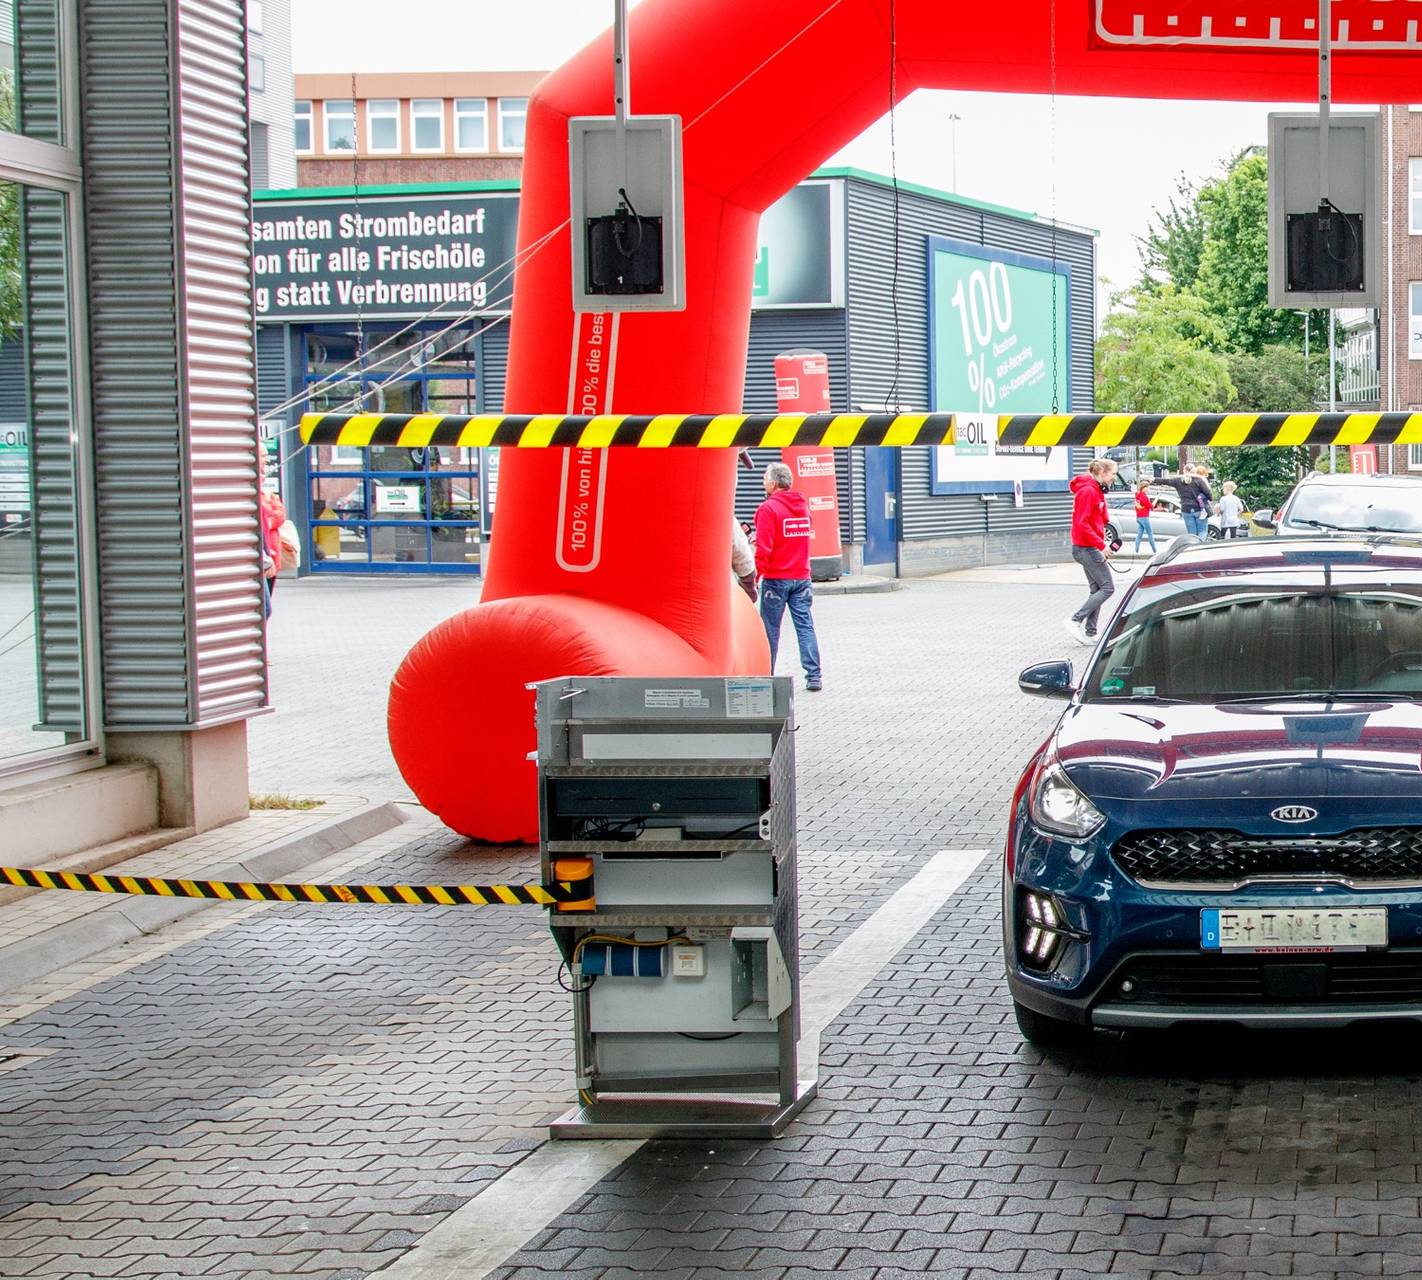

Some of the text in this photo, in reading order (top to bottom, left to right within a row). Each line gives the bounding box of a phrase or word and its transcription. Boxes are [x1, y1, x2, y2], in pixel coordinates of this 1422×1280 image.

[339, 207, 485, 239] Strombedarf
[288, 247, 322, 274] für
[328, 247, 371, 273] alle
[377, 243, 486, 271] Frischöle
[276, 281, 331, 307] statt
[336, 279, 488, 308] Verbrennung
[617, 275, 624, 285] 1
[952, 261, 1013, 357] 100
[587, 312, 605, 345] bes
[585, 349, 601, 374] die
[6, 431, 28, 446] OIL
[967, 422, 987, 444] OIL
[578, 469, 592, 497] von
[570, 502, 590, 551] 100%
[1279, 808, 1310, 818] KIA
[1207, 932, 1215, 941] D
